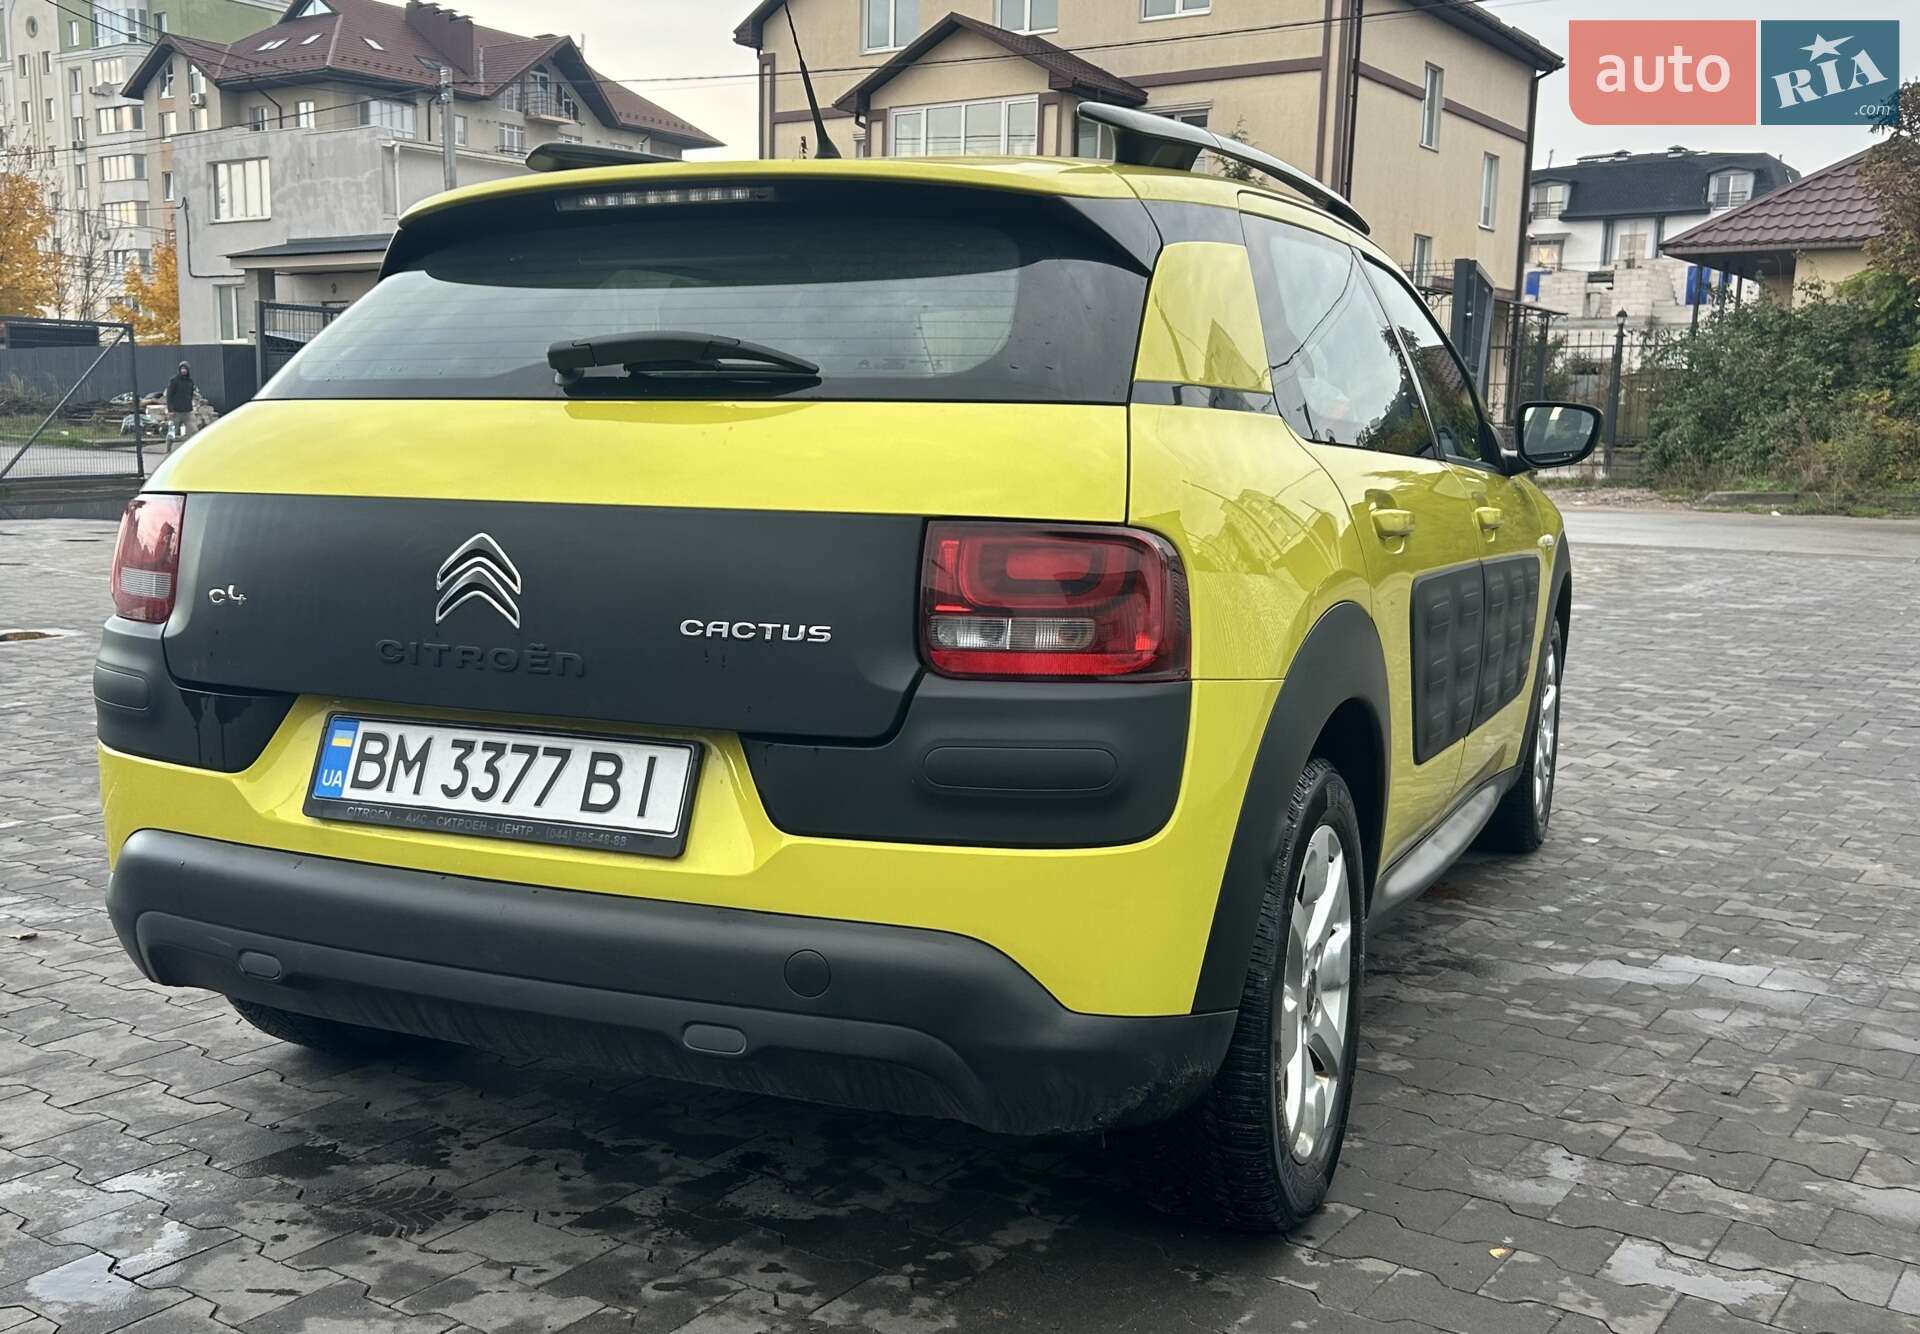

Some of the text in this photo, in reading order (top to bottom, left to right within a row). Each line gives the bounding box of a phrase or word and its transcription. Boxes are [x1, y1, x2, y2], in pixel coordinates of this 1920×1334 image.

[679, 619, 832, 643] CACTUS
[322, 768, 343, 789] UA
[350, 732, 434, 795] BM
[440, 739, 572, 807] 3377
